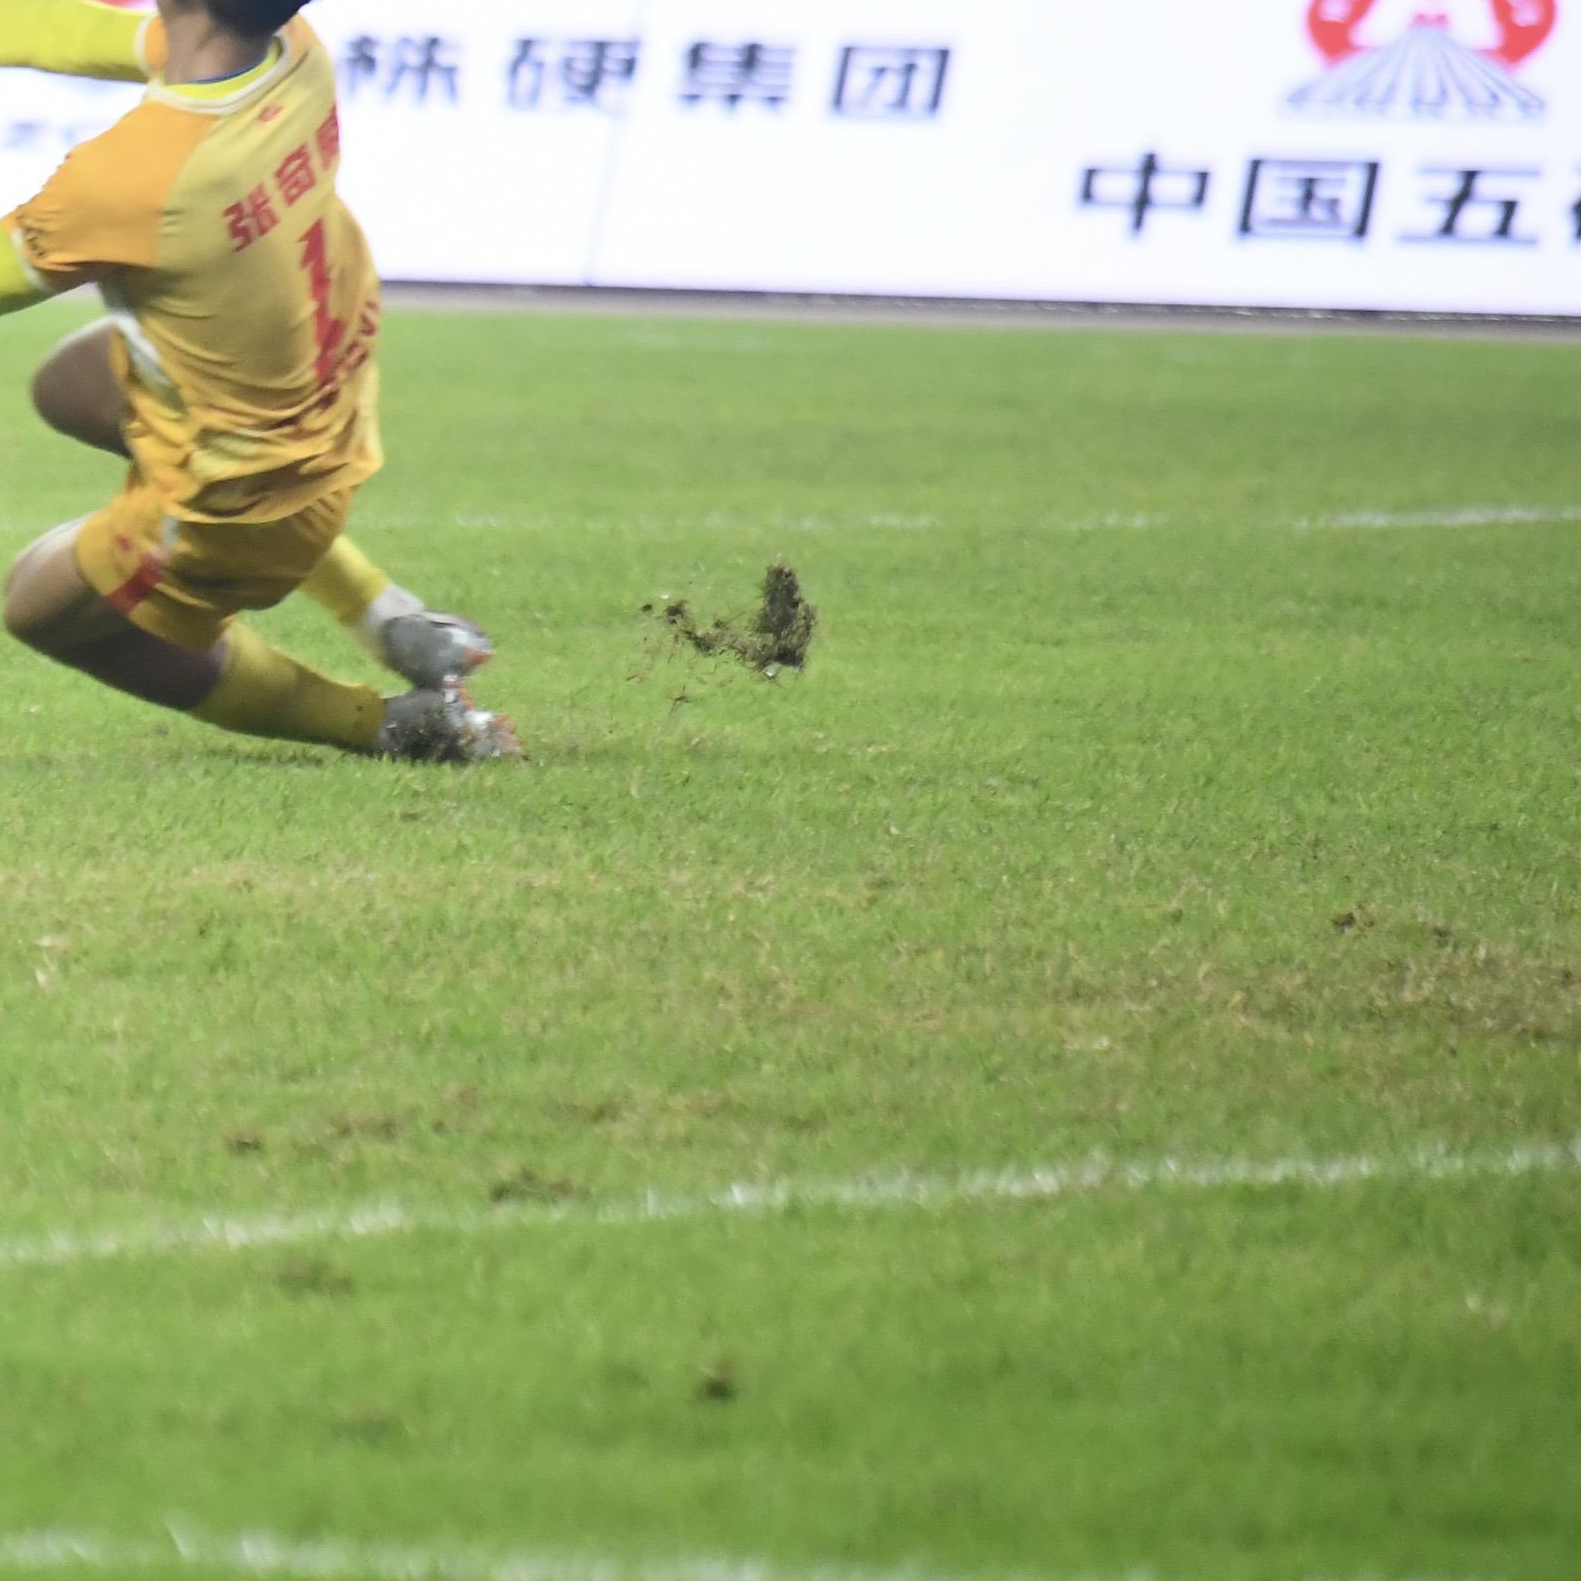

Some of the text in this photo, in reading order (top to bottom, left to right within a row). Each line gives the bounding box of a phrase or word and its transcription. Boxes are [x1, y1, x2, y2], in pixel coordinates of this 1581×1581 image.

[338, 32, 951, 116] 株硬集团
[1078, 152, 1581, 245] 中国五
[288, 217, 344, 385] 1
